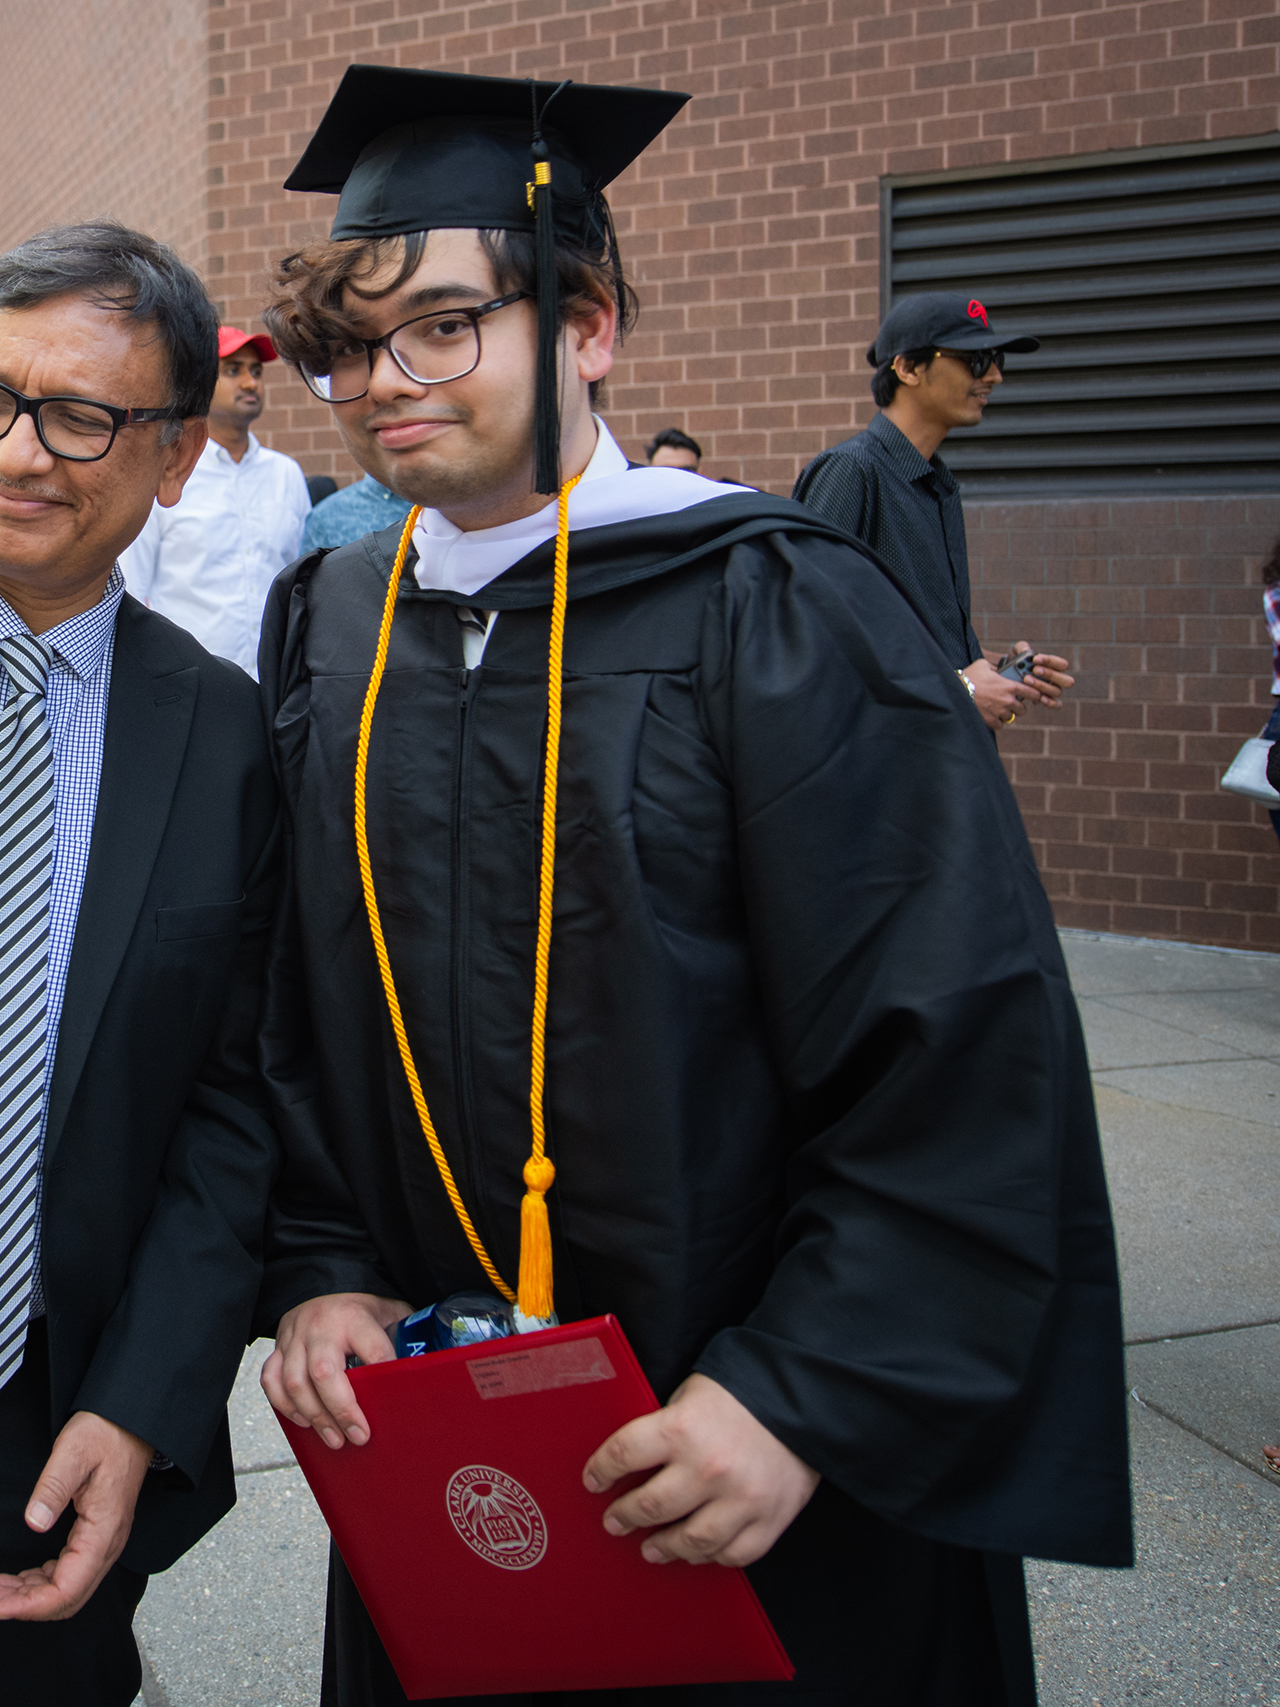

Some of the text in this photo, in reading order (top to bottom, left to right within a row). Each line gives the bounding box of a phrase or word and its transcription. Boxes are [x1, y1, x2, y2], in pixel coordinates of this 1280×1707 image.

[450, 1469, 539, 1529] CLARK UNIVERSITY
[486, 1518, 511, 1530] FIAT
[491, 1528, 517, 1541] LUX
